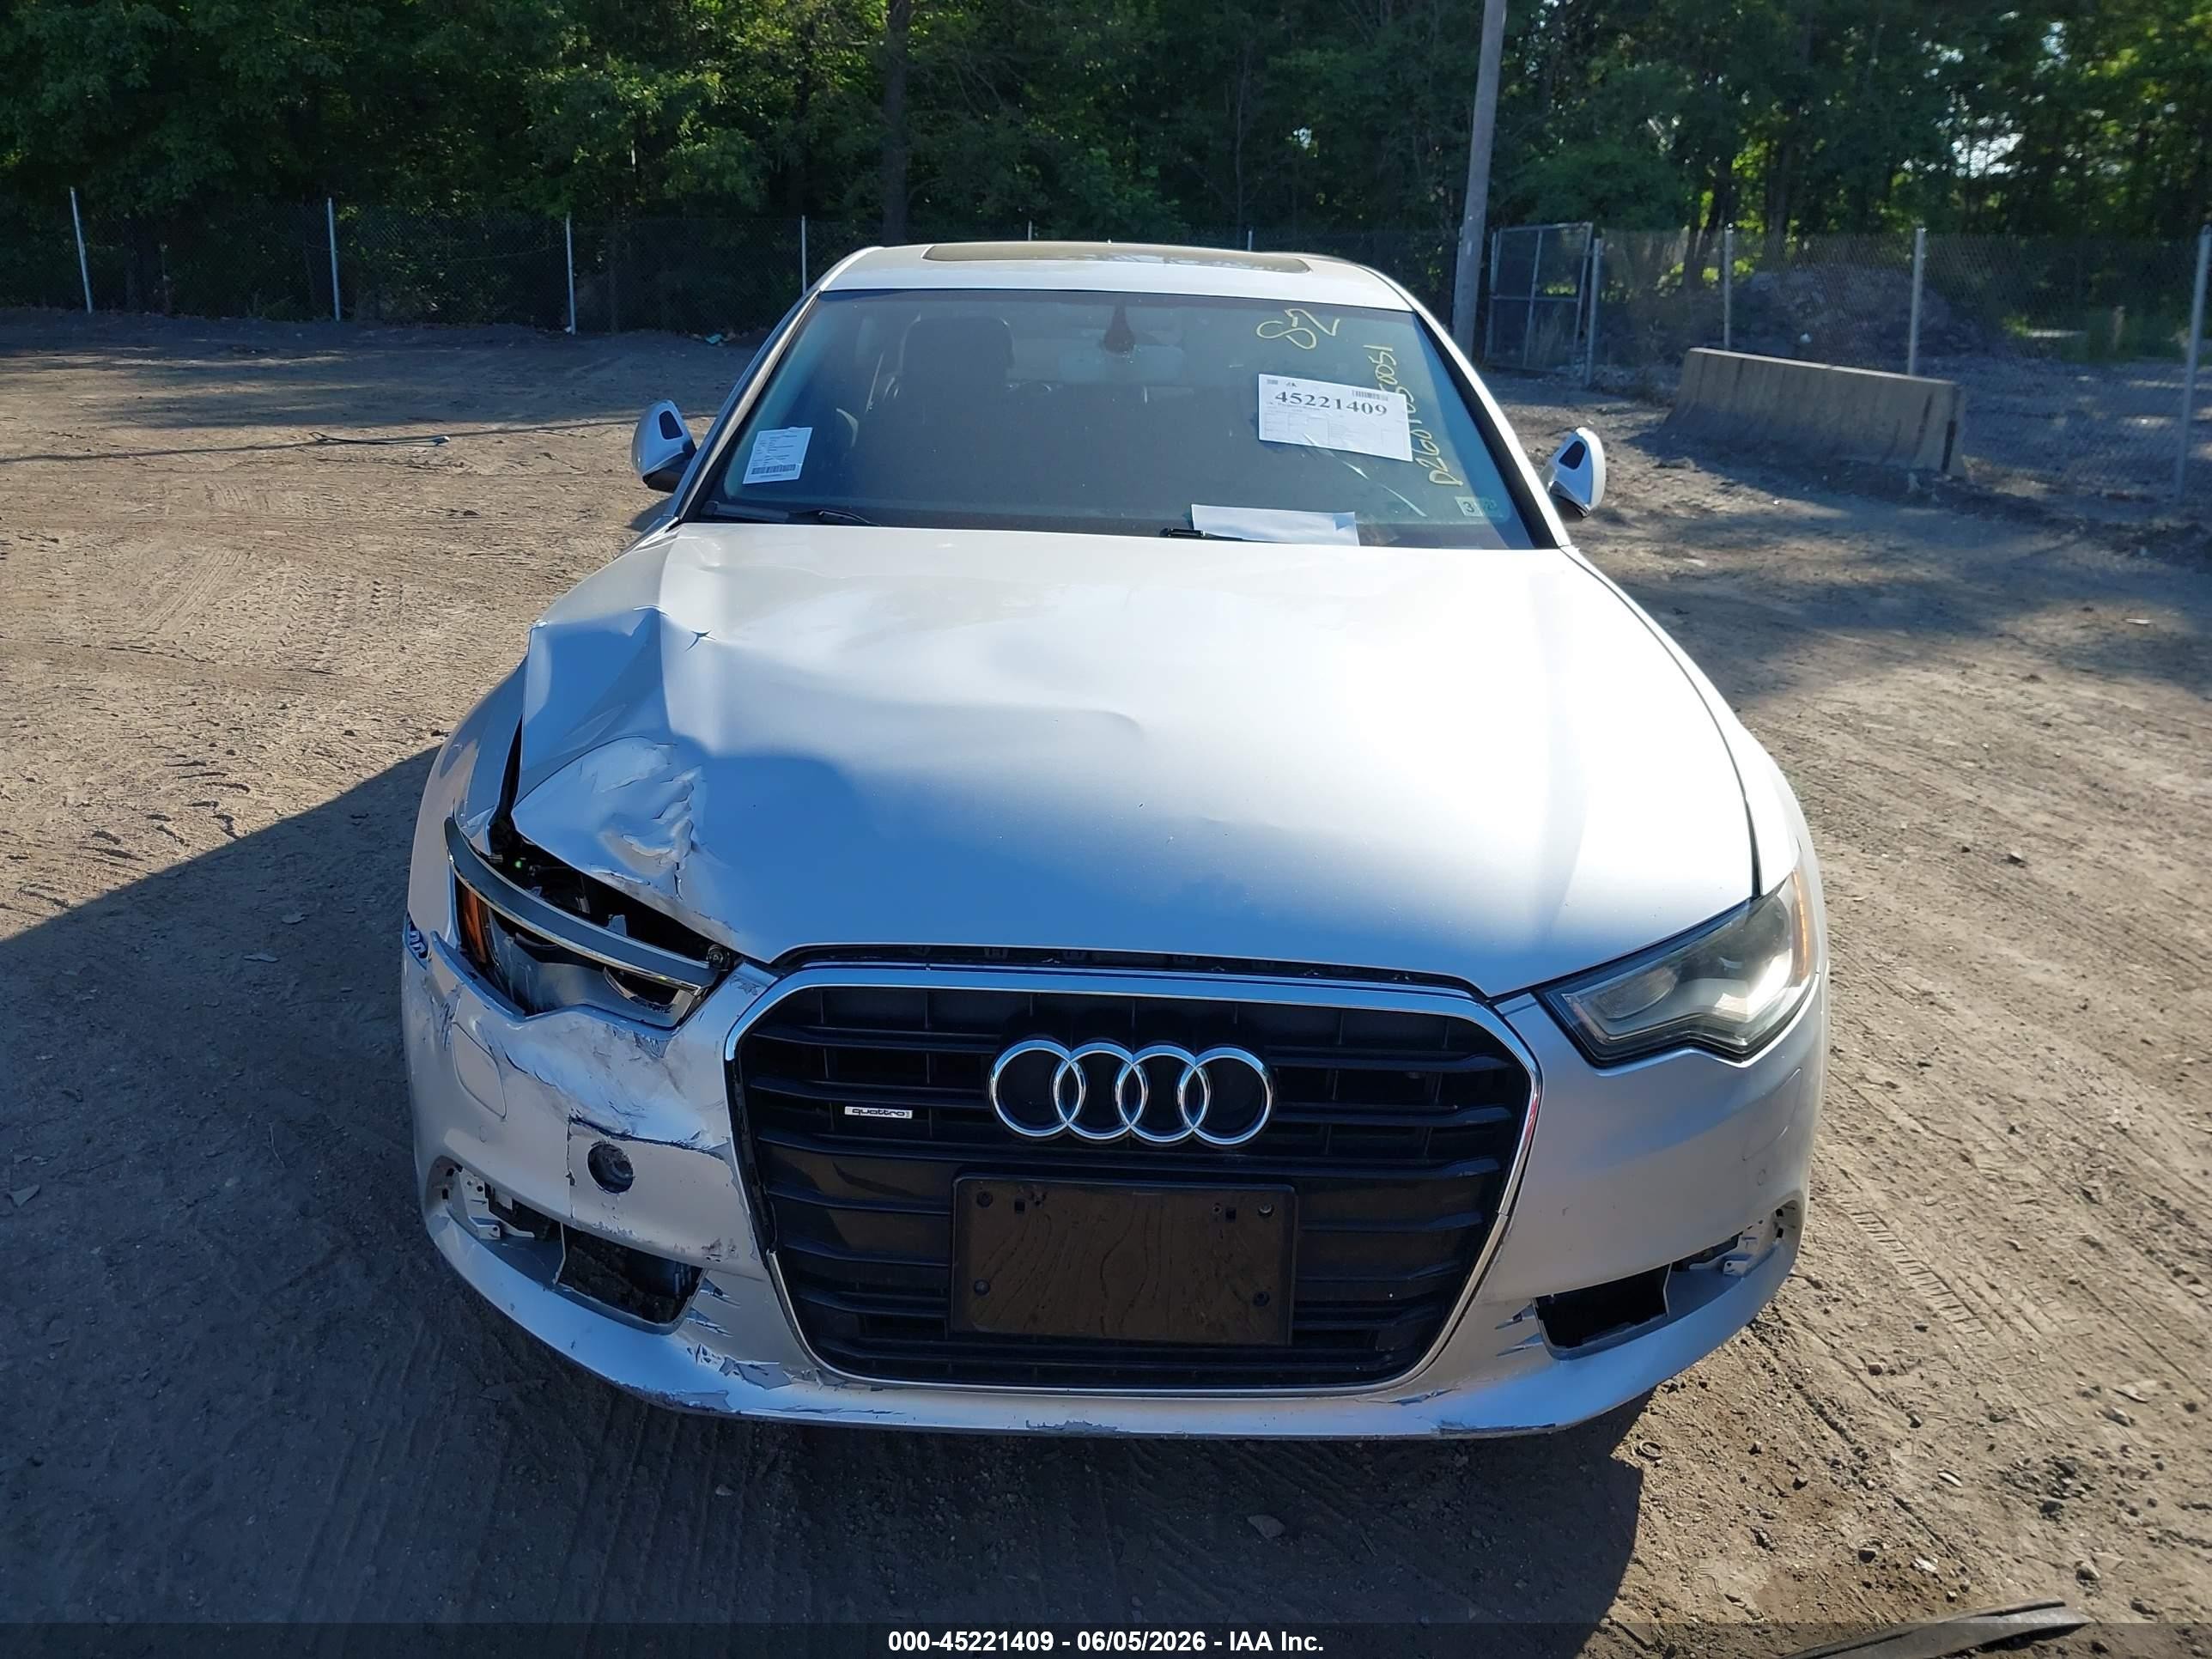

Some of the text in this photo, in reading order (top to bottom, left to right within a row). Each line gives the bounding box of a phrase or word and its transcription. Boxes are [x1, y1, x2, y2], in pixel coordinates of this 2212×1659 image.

[1275, 391, 1388, 416] 45221409
[1462, 501, 1475, 513] 3
[852, 1108, 905, 1117] quattro
